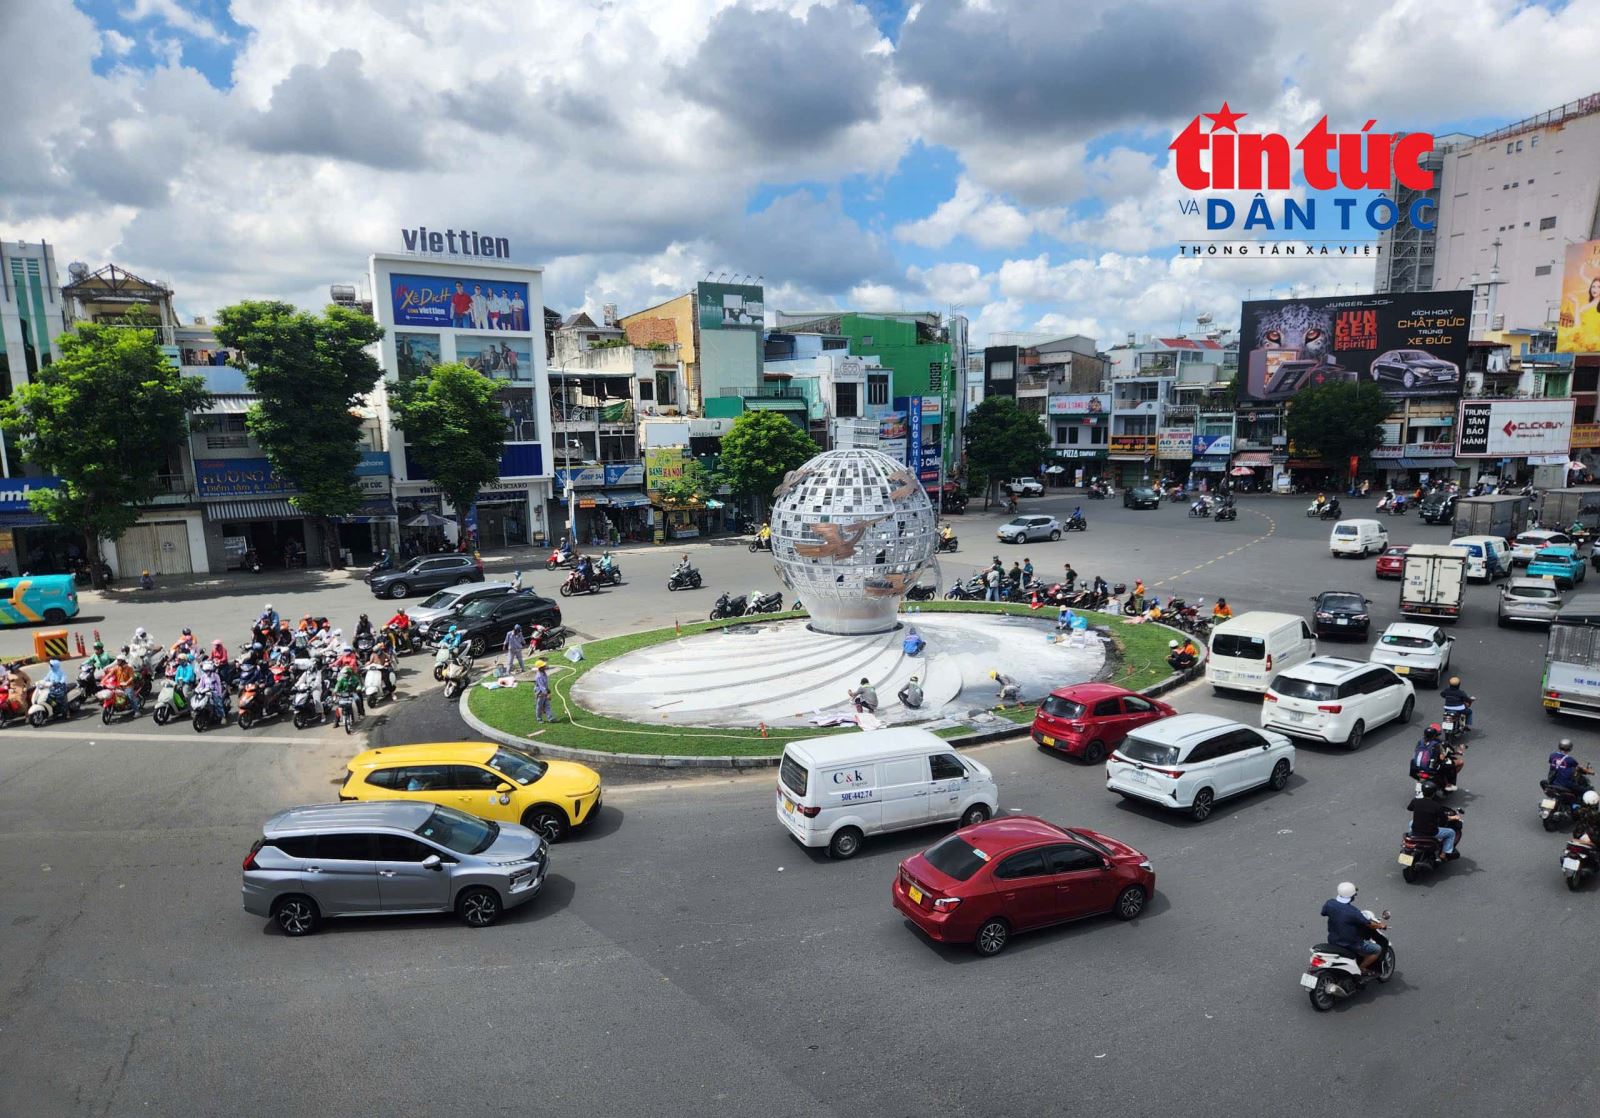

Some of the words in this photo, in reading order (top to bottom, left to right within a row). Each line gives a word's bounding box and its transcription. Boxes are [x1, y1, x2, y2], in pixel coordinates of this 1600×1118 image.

[402, 227, 510, 258] viettien
[1436, 315, 1465, 327] ĐỨC
[1408, 337, 1423, 345] XE
[1426, 334, 1452, 345] ĐỨC
[1466, 426, 1484, 435] BẢO
[1462, 436, 1487, 445] HÀNH
[1063, 449, 1078, 458] PIZZA
[833, 772, 844, 784] C
[841, 790, 873, 801] 50E-442.74
